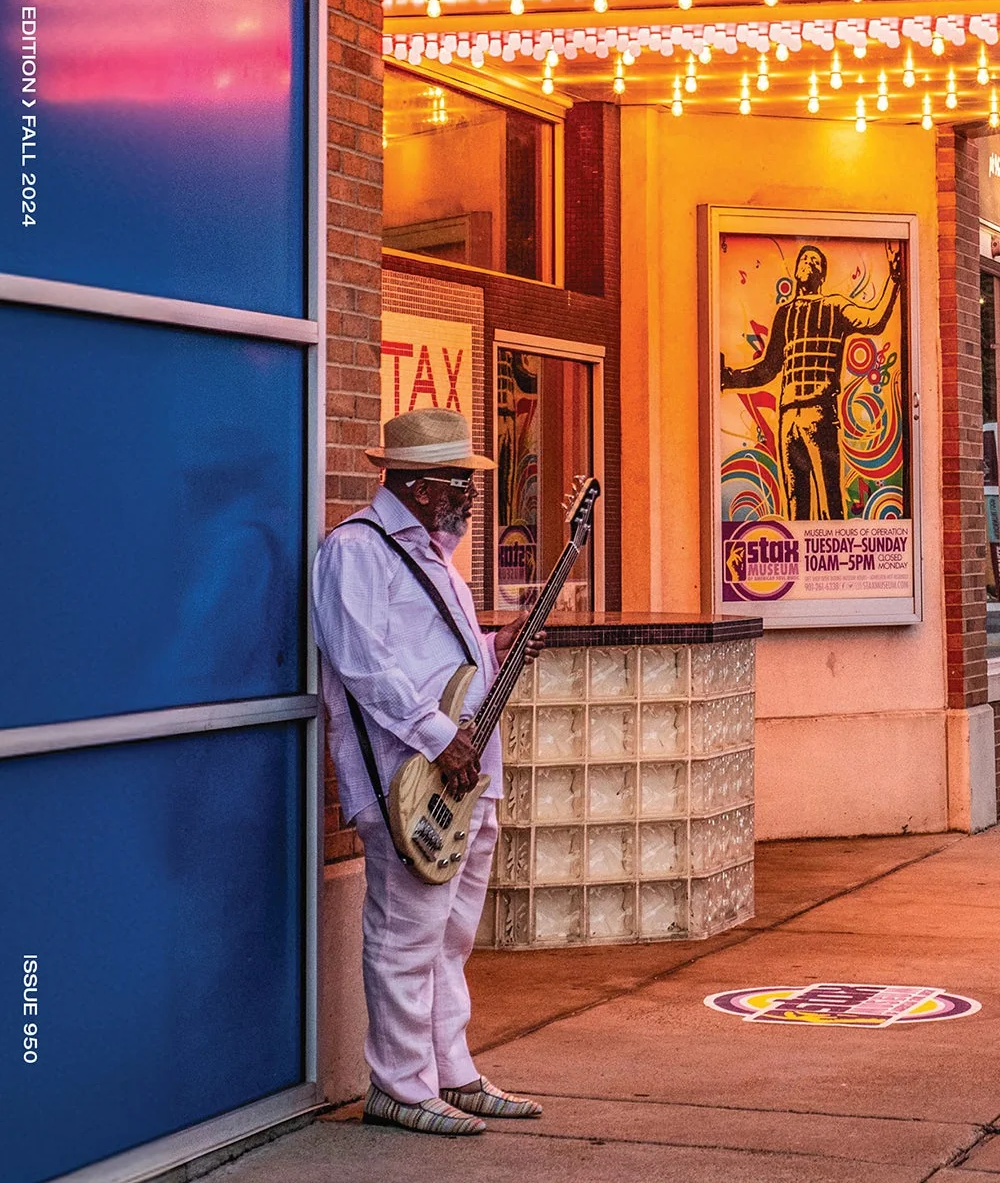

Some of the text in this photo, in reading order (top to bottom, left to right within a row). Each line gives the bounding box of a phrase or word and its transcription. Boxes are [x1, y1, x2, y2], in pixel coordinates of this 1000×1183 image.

[804, 527, 909, 537] MUSEUM HOURS OF OPERATION
[747, 537, 799, 563] stax
[877, 553, 903, 562] CLOSED
[748, 563, 799, 576] MUSEUM
[877, 562, 909, 570] MONDAY
